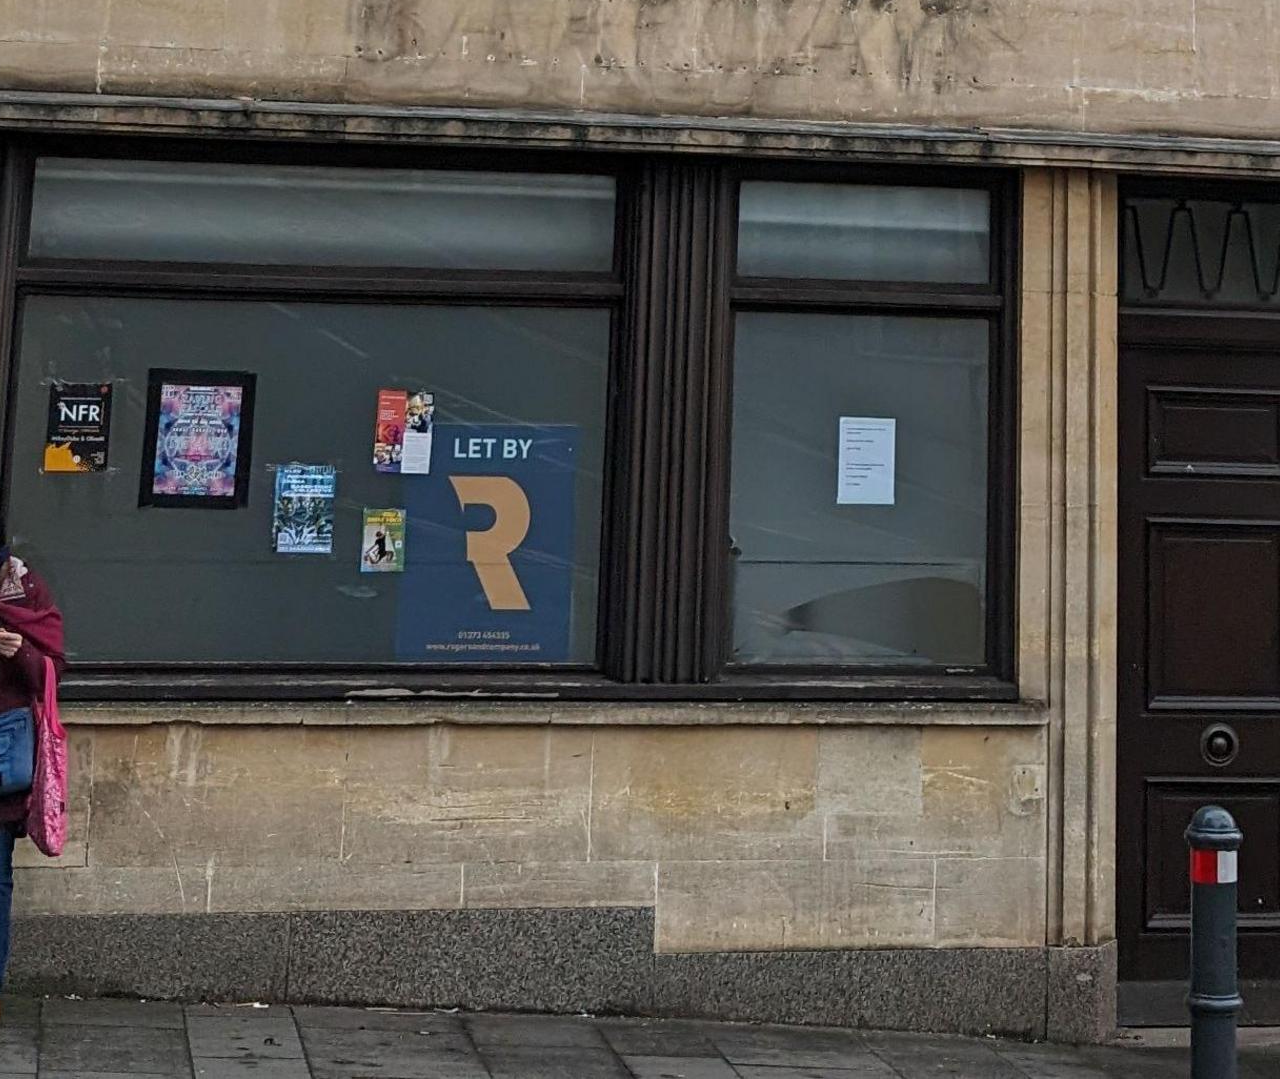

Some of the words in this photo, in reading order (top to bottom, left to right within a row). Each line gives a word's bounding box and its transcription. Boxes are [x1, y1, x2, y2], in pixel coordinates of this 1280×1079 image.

[60, 404, 100, 421] NFR
[453, 438, 496, 458] LET
[503, 438, 533, 459] BY
